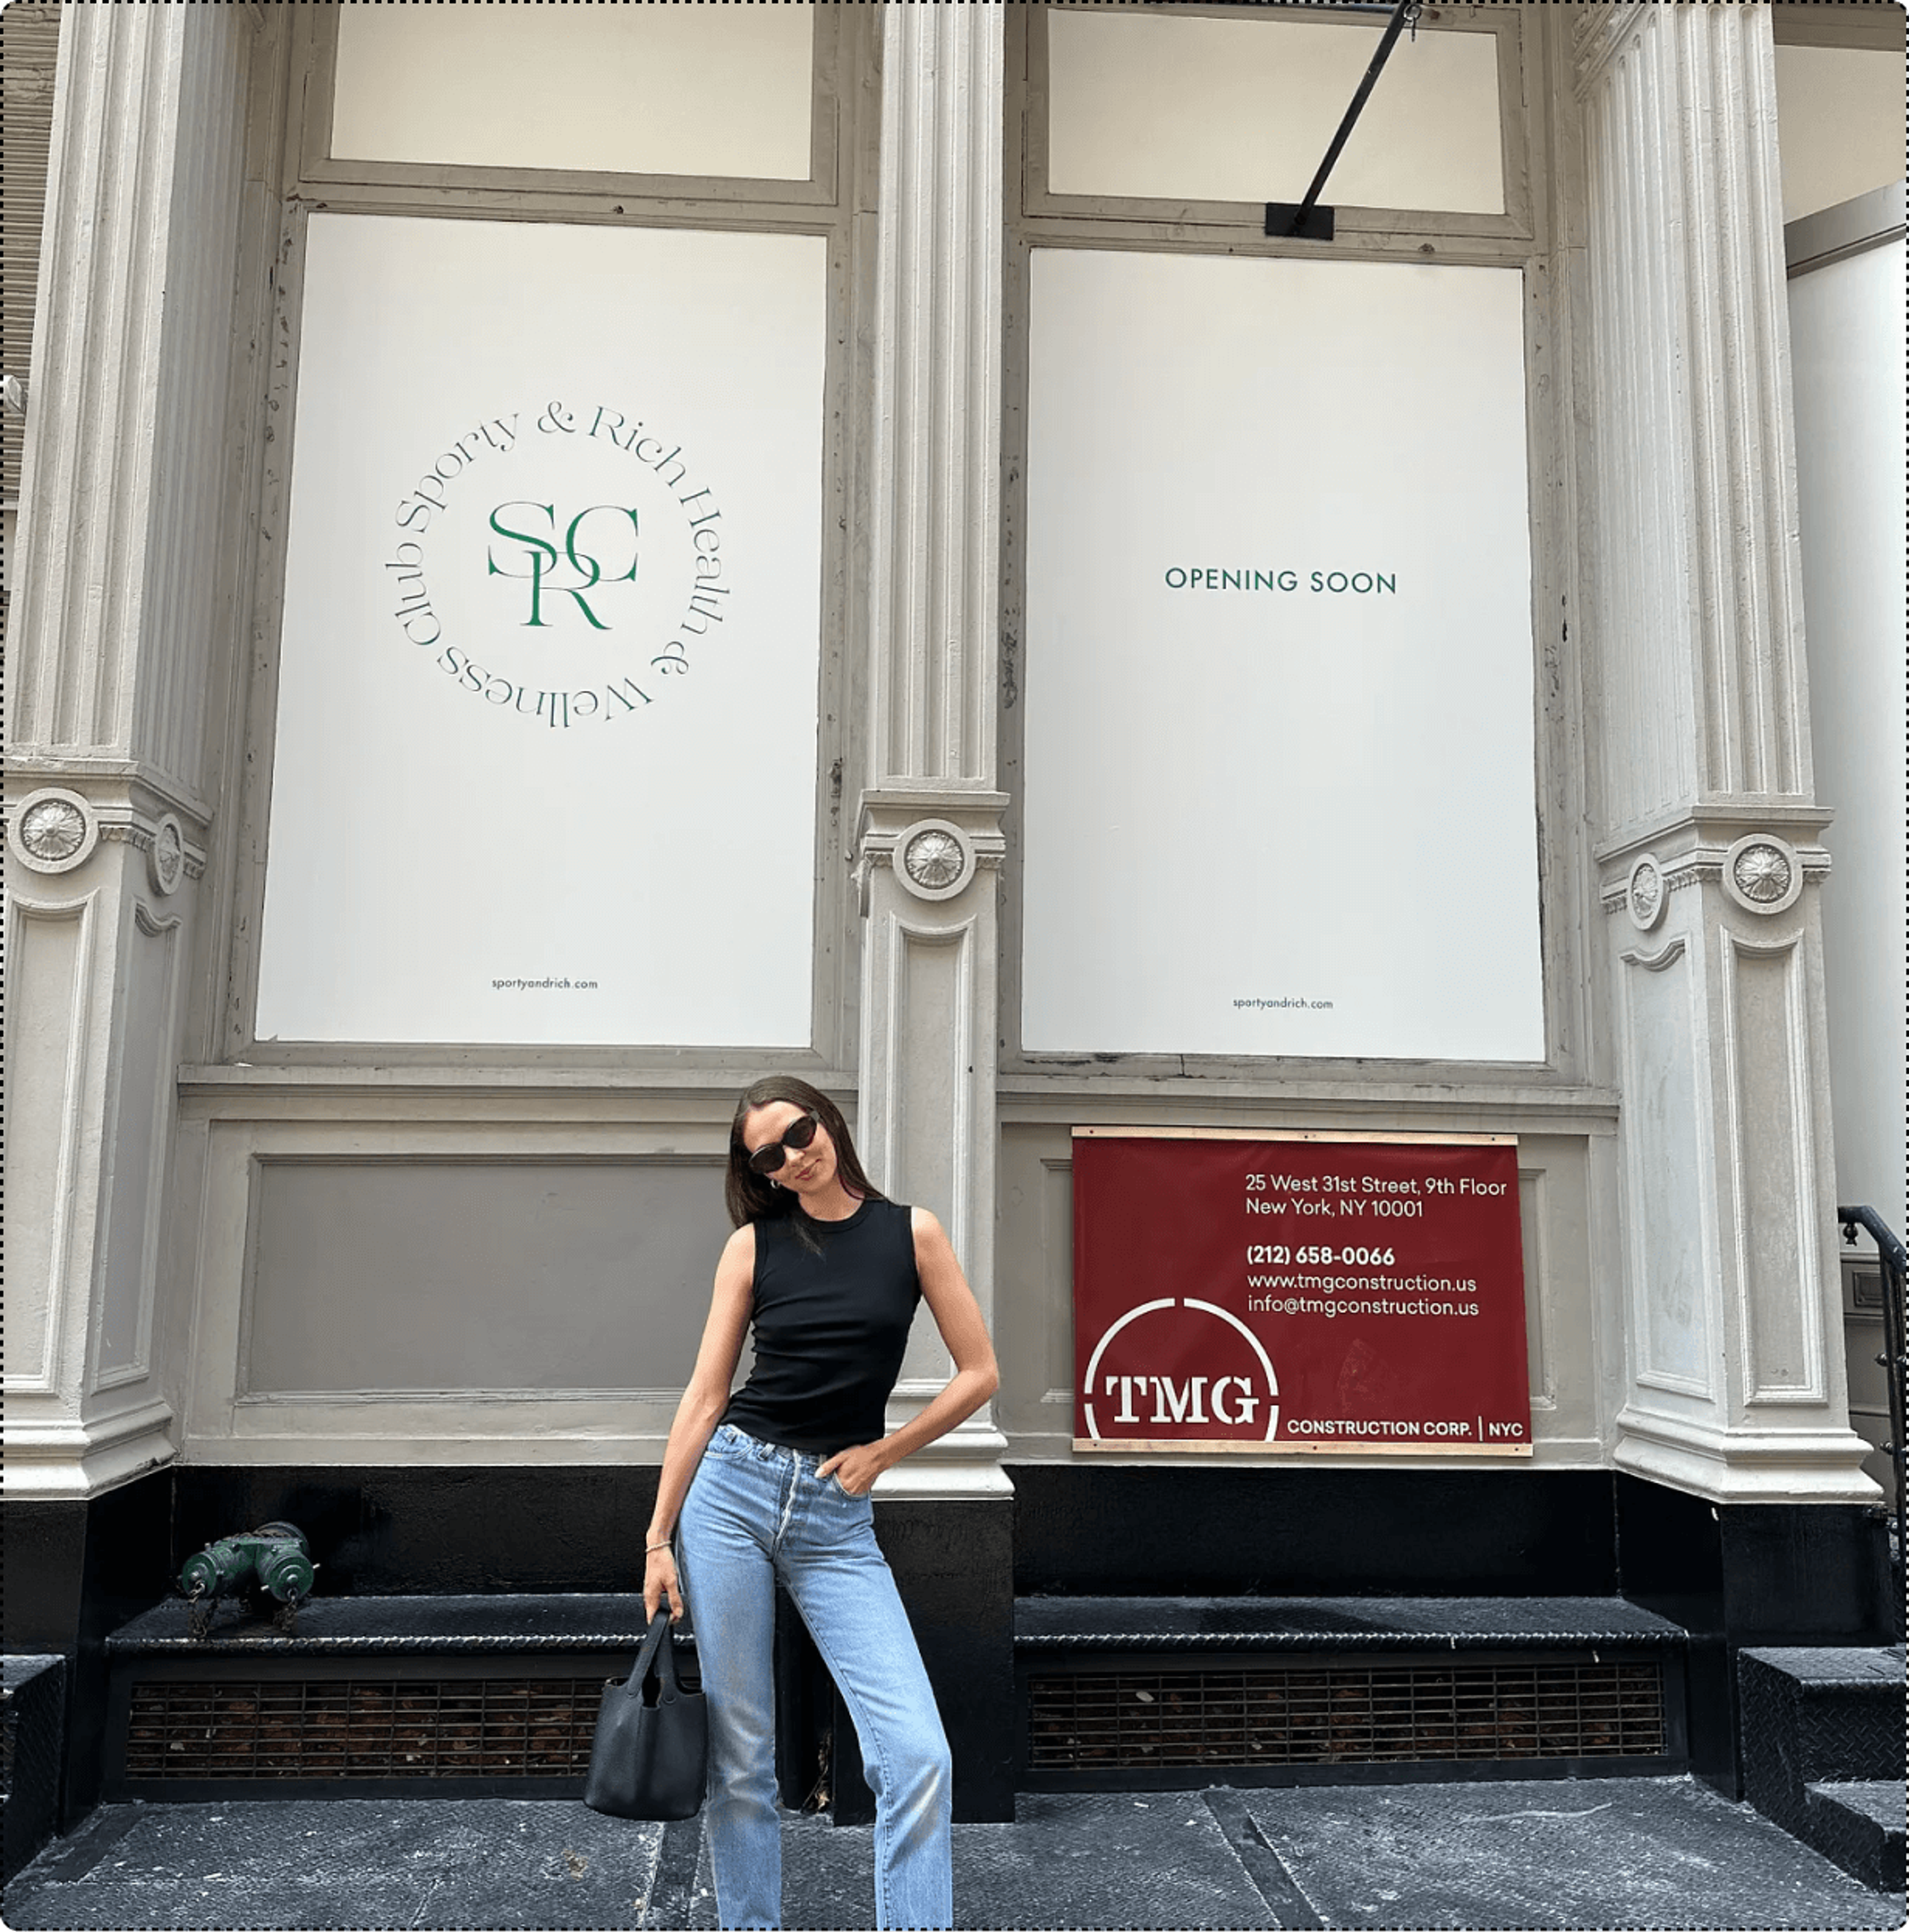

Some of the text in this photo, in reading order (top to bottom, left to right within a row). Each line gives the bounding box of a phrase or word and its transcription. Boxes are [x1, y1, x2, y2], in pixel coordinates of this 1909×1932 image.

[384, 401, 731, 729] Sporty & Rich Health & Wellness Club
[1165, 567, 1396, 594] OPENING SOON
[492, 977, 598, 991] sportyandrich.com
[1233, 997, 1334, 1010] sportyandrich.com
[1246, 1174, 1507, 1195] 25 West 31st Street, 9th Floor
[1246, 1197, 1422, 1217] New York, NY 10001
[1247, 1245, 1395, 1266] (212) 658-0066
[1247, 1273, 1476, 1294] www.tmgconstruction.us
[1248, 1294, 1479, 1318] info@tmgconstruction.us
[1106, 1376, 1259, 1425] TMG
[1287, 1420, 1523, 1436] CONSTRUCTION CORP. NYC
